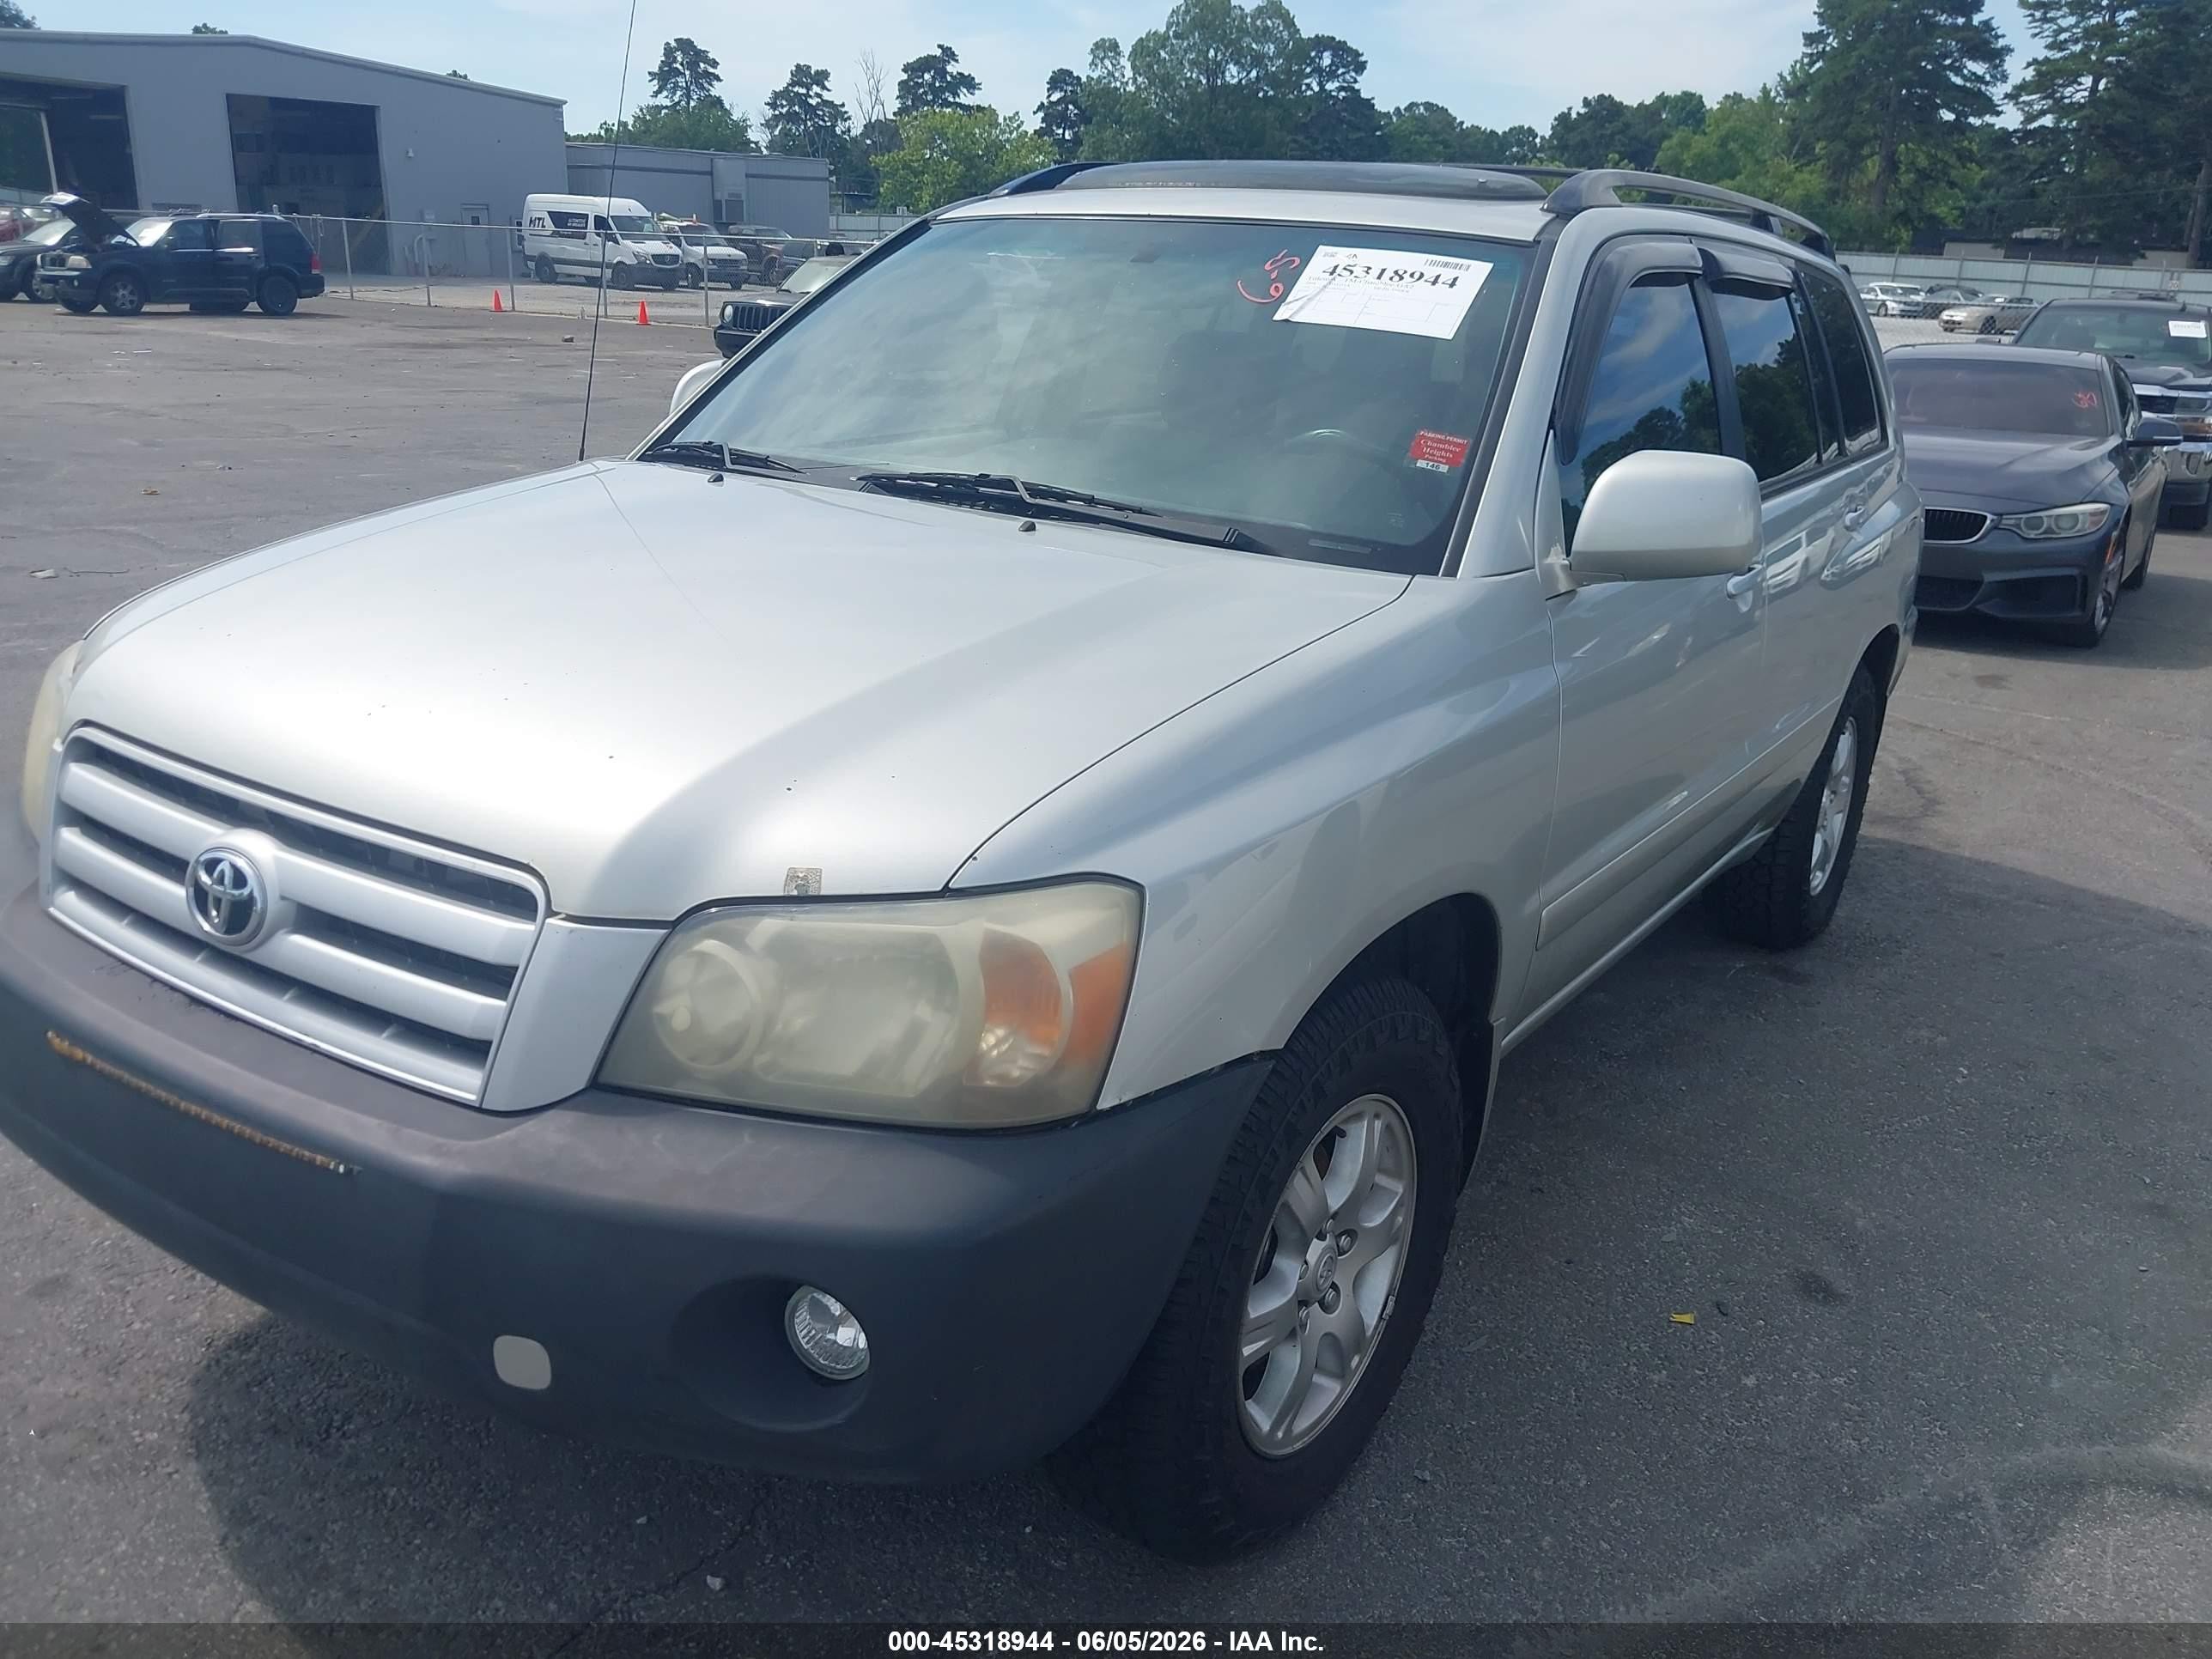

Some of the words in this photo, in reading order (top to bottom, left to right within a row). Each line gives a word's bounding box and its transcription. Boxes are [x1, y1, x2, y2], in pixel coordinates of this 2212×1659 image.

[1322, 264, 1459, 289] 45318944
[1419, 431, 1445, 440] PARKING
[1423, 447, 1453, 458] Heights
[1425, 462, 1440, 471] 146
